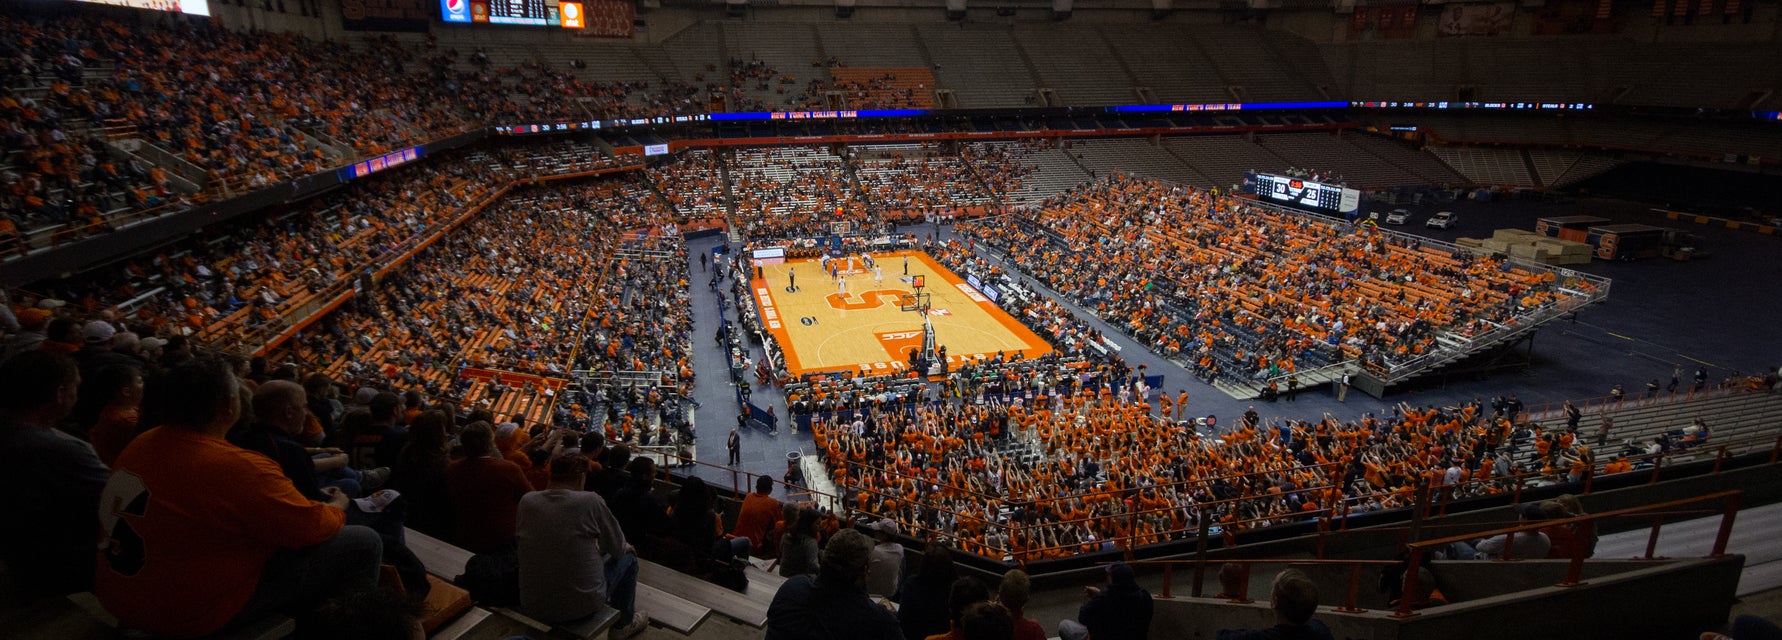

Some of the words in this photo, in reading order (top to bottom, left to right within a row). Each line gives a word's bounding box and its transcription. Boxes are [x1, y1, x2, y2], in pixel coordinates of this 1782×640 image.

[788, 111, 810, 119] YORK'S
[840, 110, 857, 118] TEAM
[1276, 184, 1286, 194] 30
[1306, 189, 1317, 199] 25
